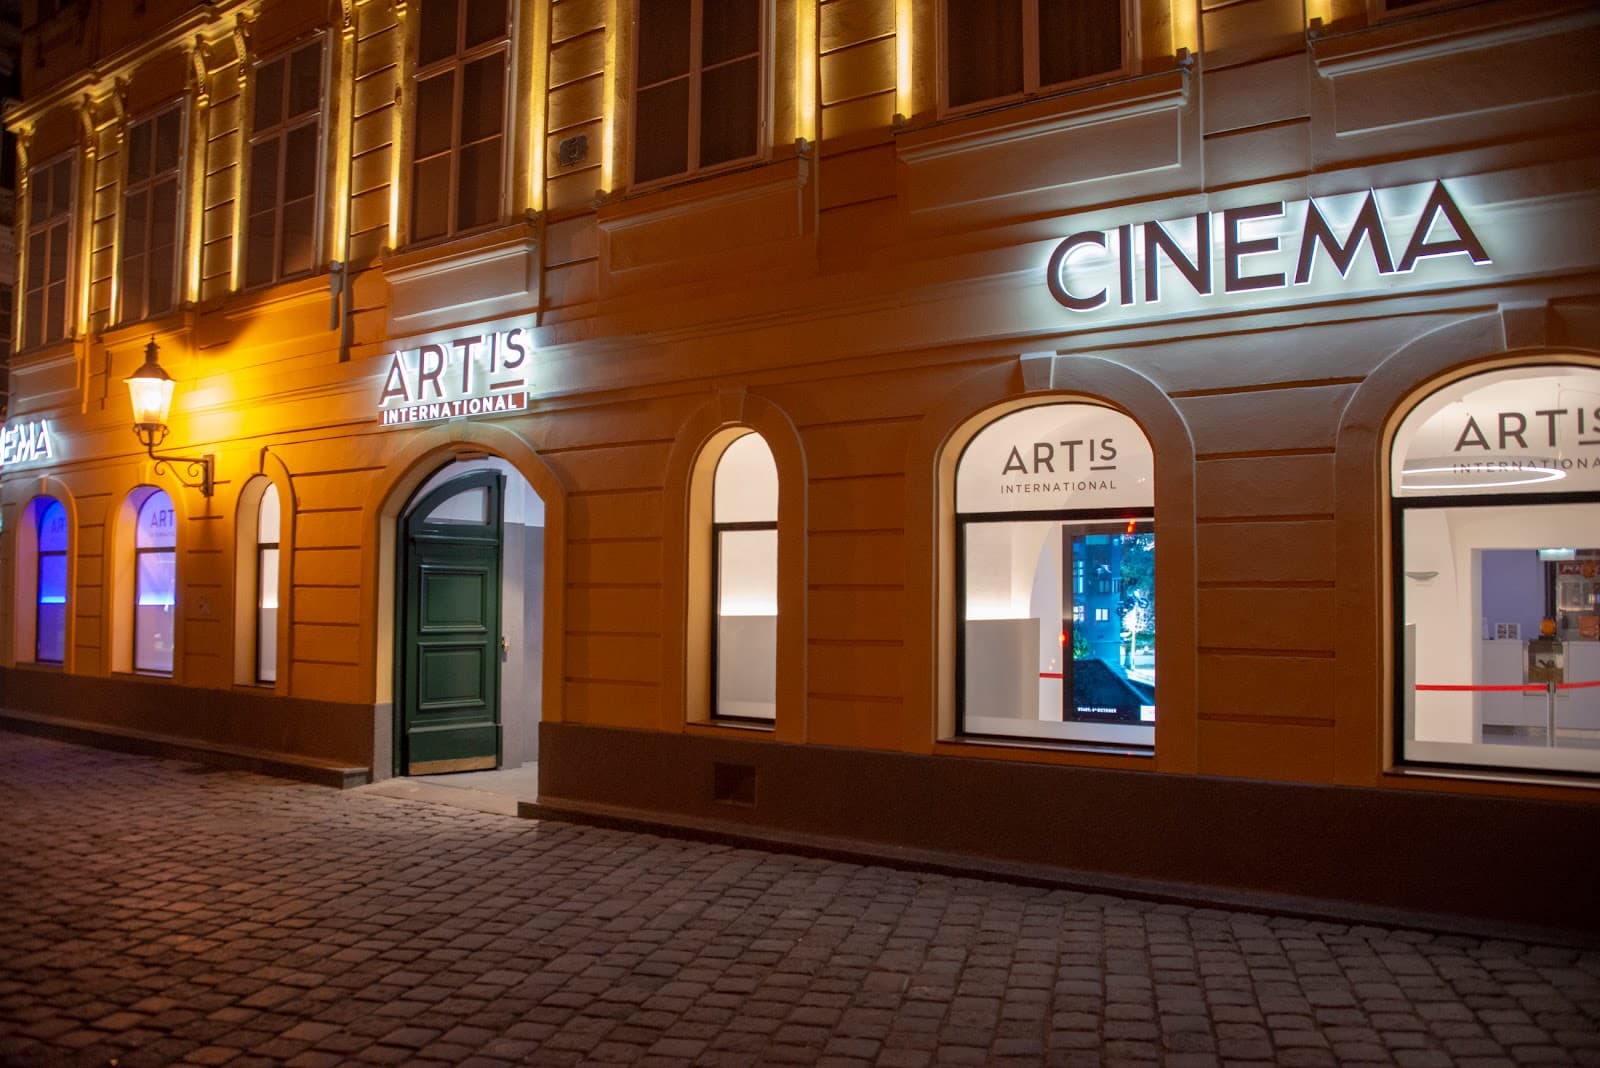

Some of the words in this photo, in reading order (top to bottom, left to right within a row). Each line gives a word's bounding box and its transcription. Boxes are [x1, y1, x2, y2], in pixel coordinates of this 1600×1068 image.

[1046, 178, 1493, 312] CINEMA
[378, 328, 527, 407] ARTIS
[383, 394, 517, 425] INTERNATIONAL
[0, 419, 52, 466] EMA
[1002, 438, 1117, 475] ARTIS
[1001, 480, 1117, 494] INTERNATIONAL
[50, 516, 67, 534] AR
